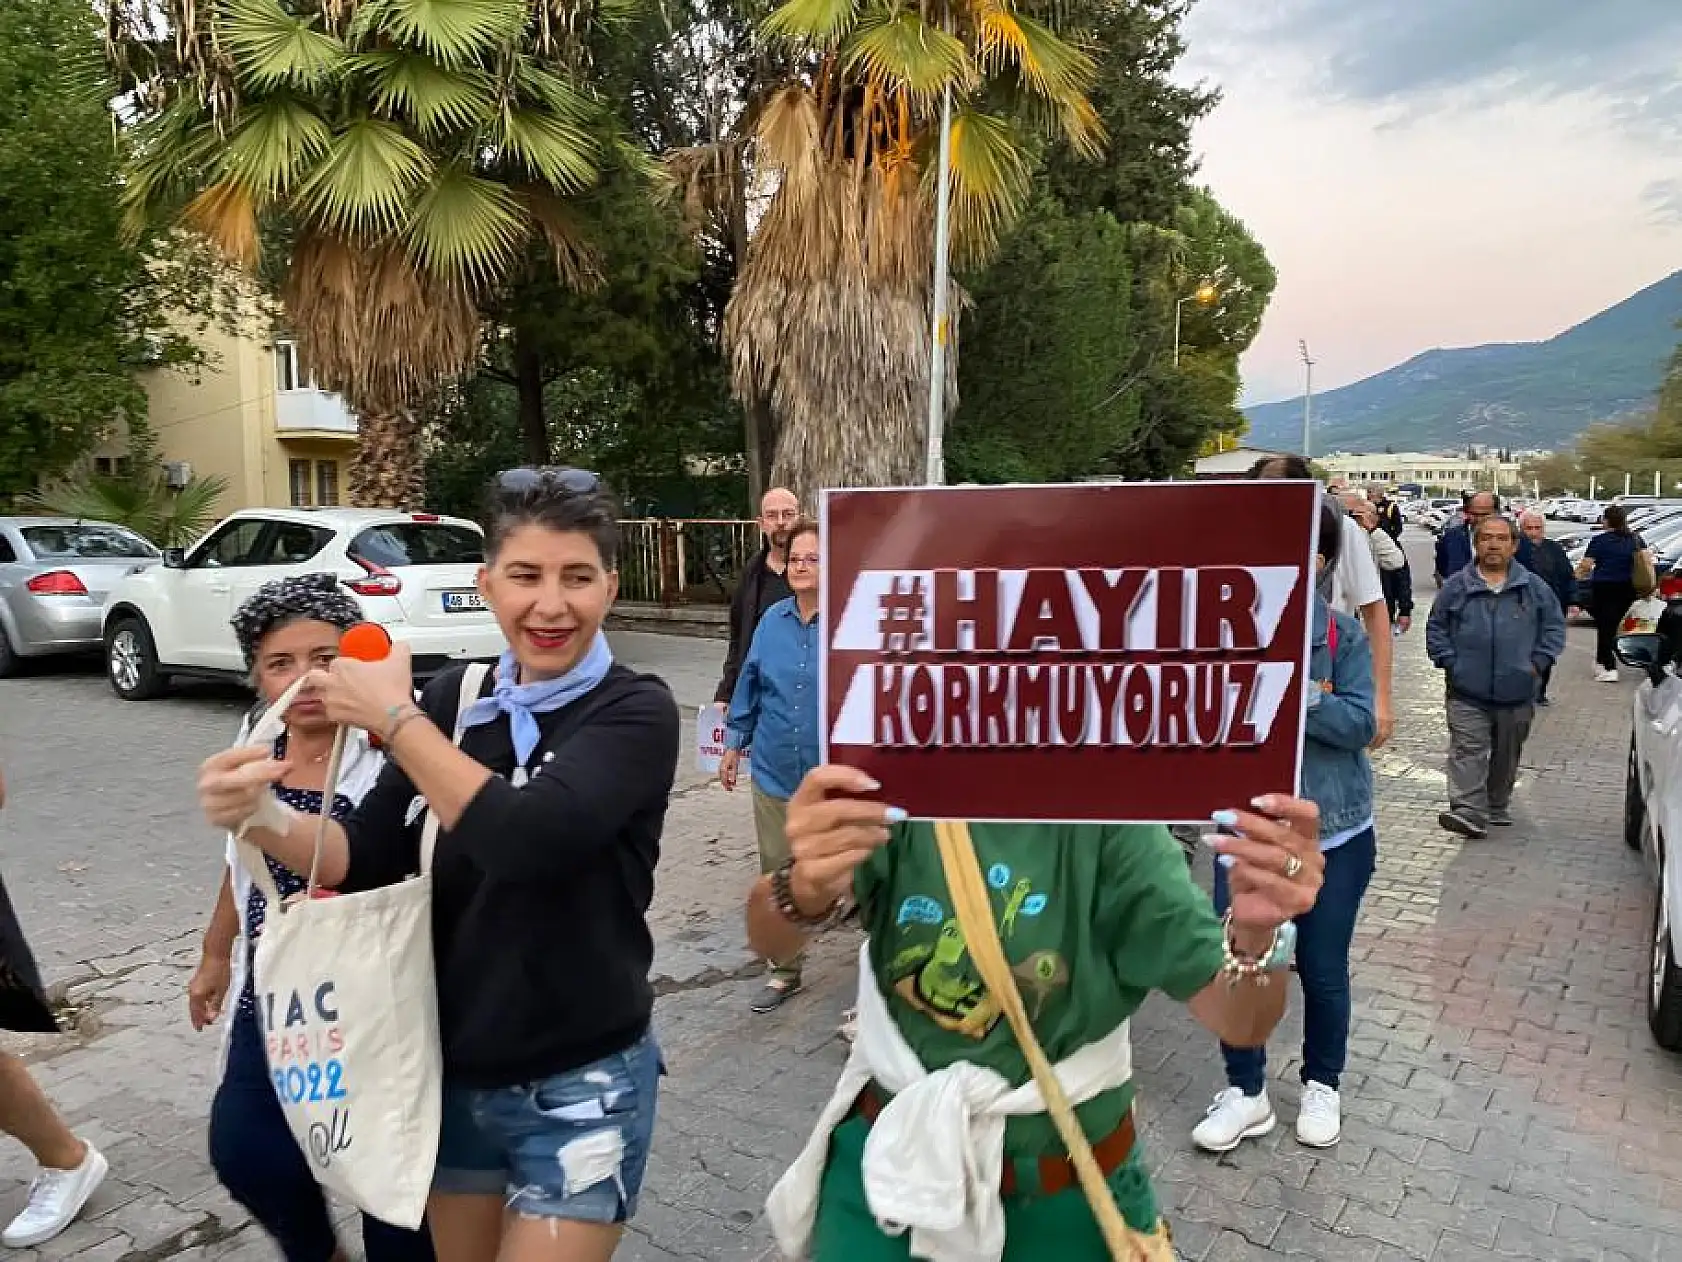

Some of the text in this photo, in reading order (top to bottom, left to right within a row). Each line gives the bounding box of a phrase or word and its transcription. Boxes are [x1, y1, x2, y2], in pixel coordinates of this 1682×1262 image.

[879, 566, 1261, 653] #HAYIR
[872, 662, 1261, 747] KORKMUYORUZ
[266, 1027, 345, 1061] PARIS
